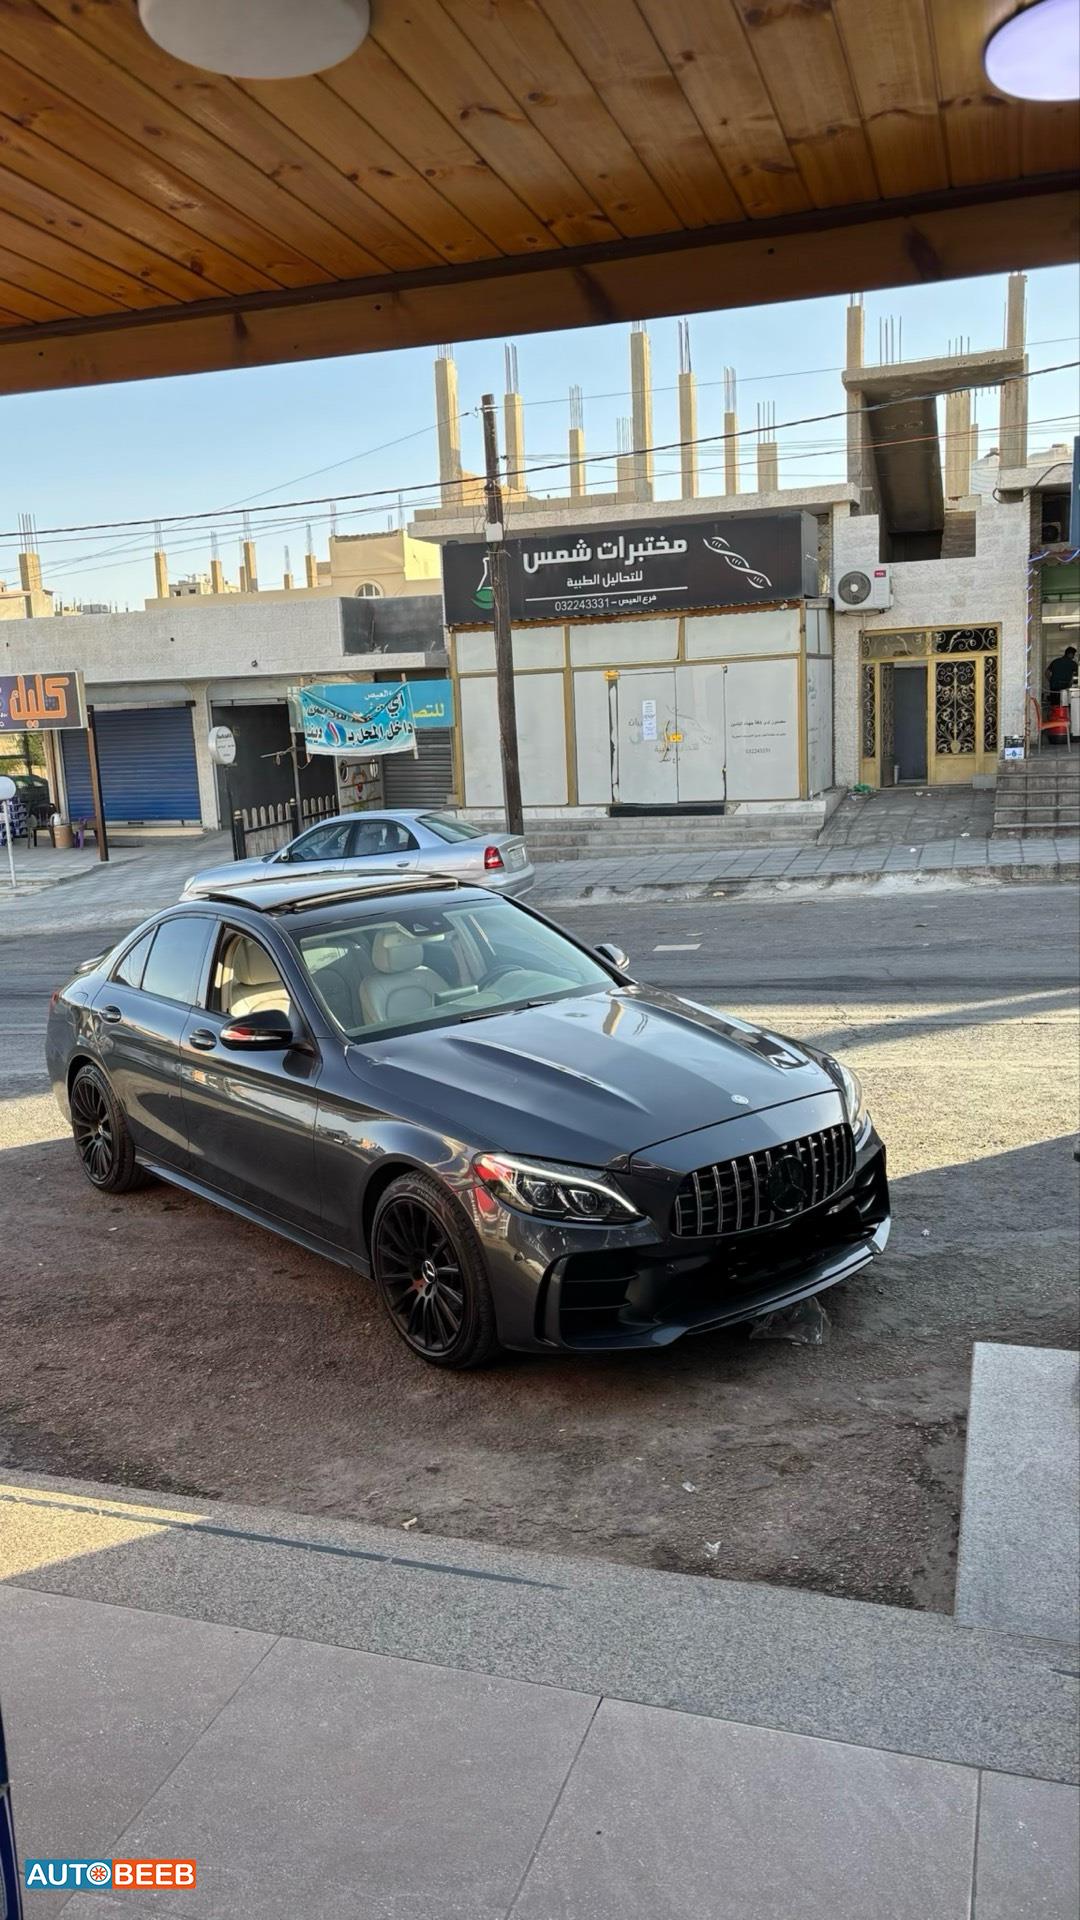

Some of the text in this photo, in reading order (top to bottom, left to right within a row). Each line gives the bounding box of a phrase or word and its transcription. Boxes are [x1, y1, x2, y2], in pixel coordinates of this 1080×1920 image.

[522, 535, 688, 574] مختبرات شمس
[566, 569, 644, 589] للتحاليل الطبية
[554, 598, 610, 612] 032243331
[618, 594, 642, 606] العيص
[642, 594, 657, 605] فرع
[9, 673, 70, 729] كليك
[357, 723, 383, 744] المحل
[386, 721, 414, 741] داخل
